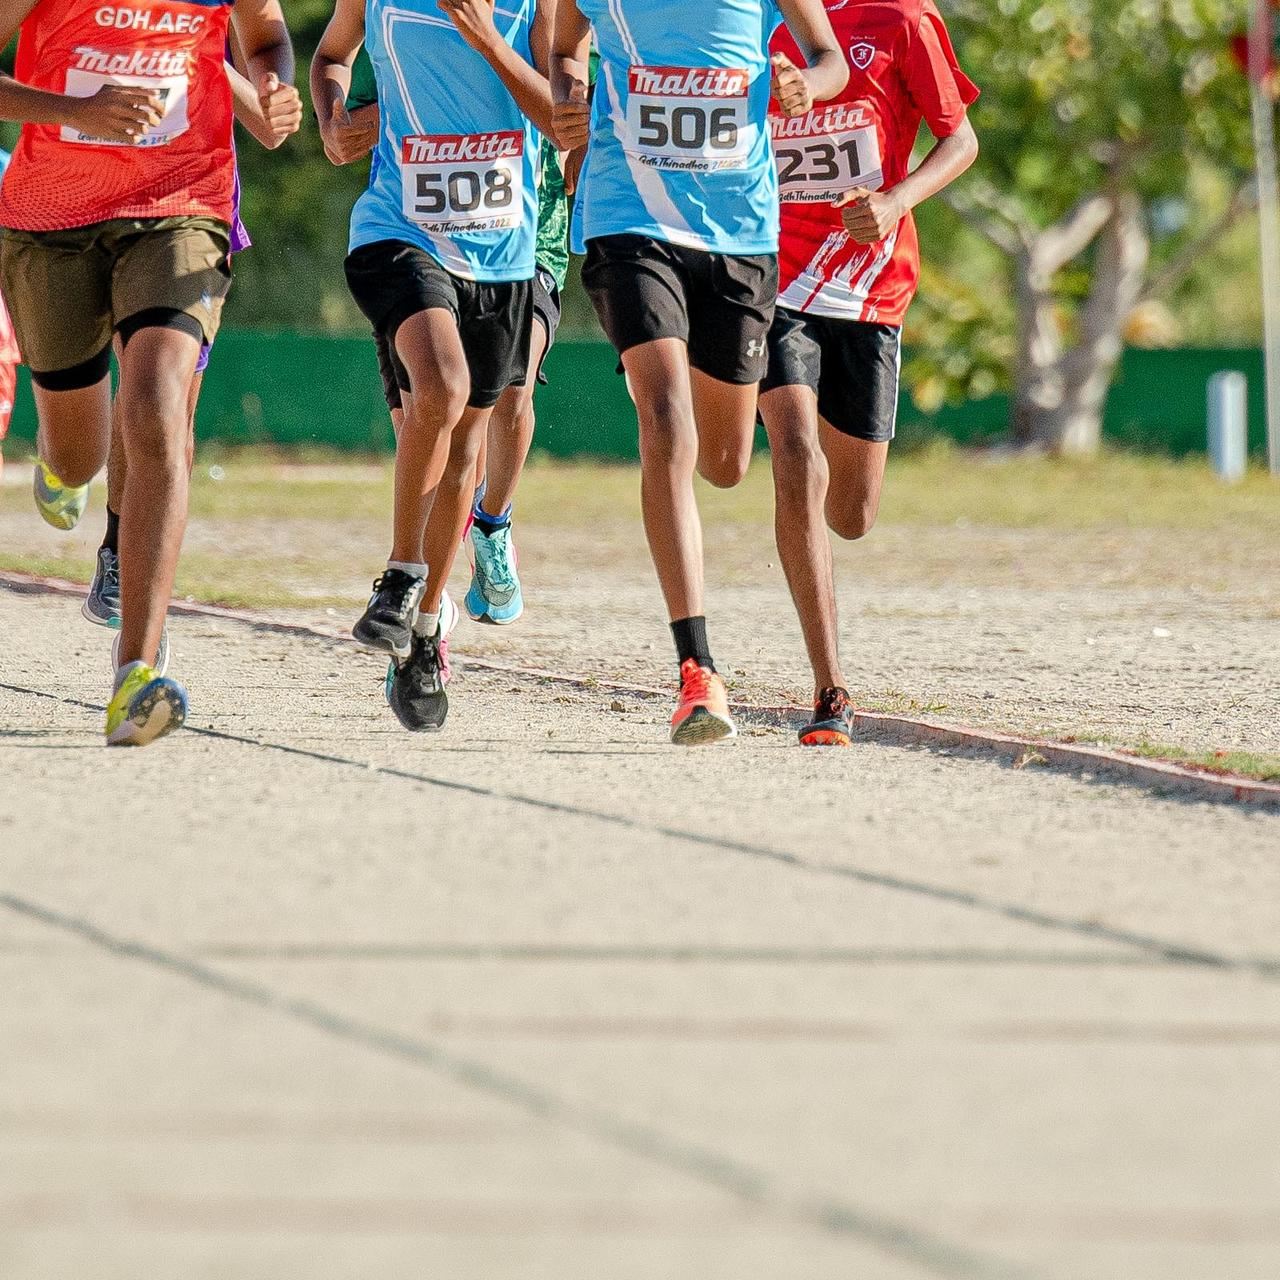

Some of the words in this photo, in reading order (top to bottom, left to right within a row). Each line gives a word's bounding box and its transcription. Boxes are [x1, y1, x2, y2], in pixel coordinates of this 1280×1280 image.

[638, 105, 738, 149] 506
[775, 140, 861, 186] 231
[415, 168, 513, 213] 508
[795, 190, 837, 201] Thinadho
